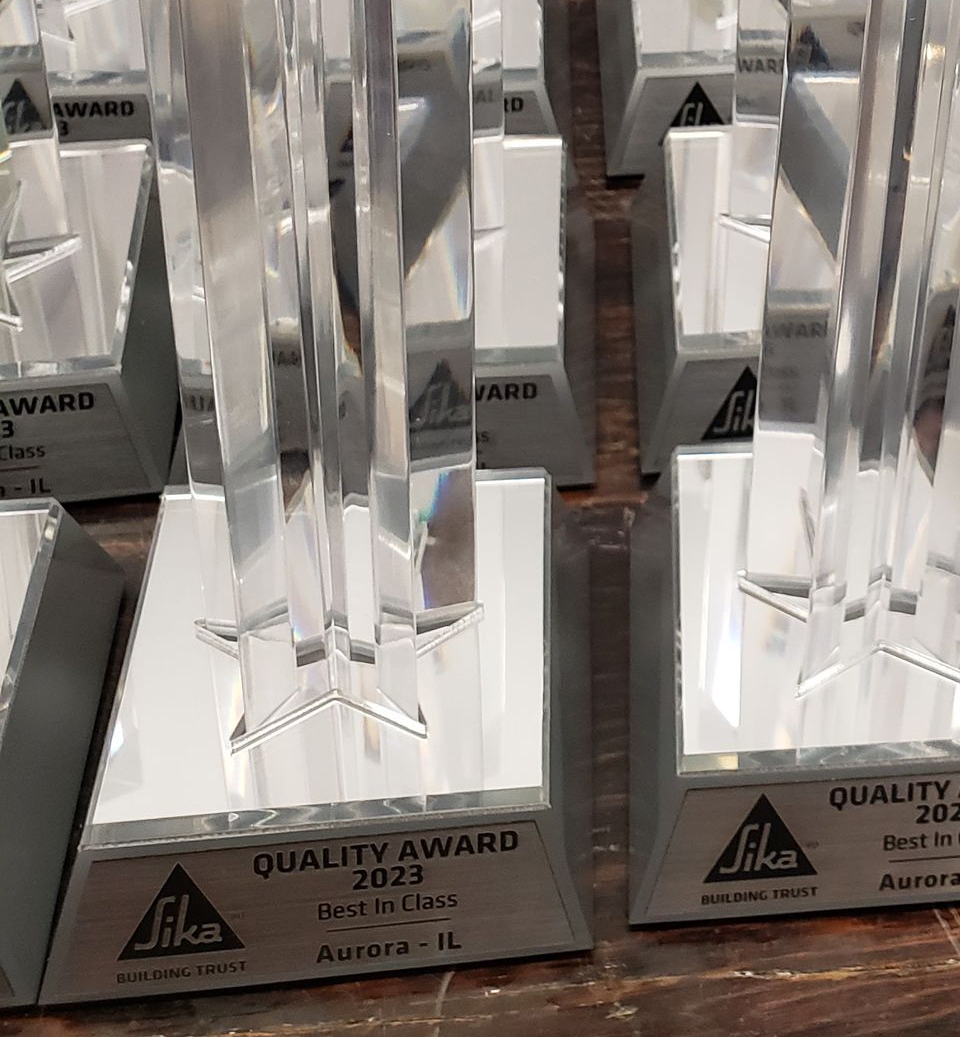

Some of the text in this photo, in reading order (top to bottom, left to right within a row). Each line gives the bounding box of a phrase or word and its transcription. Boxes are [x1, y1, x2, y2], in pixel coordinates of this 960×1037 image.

[30, 477, 51, 495] IL
[829, 779, 951, 811] QUALITY
[253, 830, 519, 879] QUALITY AWARD
[719, 822, 798, 875] Sika
[883, 832, 927, 852] Best
[934, 831, 952, 847] In
[352, 864, 424, 890] 2023
[317, 892, 459, 921] Best In Class
[701, 886, 818, 905] BUILDING TRUST
[134, 894, 223, 951] Sika
[316, 939, 409, 963] Aurora
[438, 931, 463, 951] IL
[116, 960, 247, 984] BUILDING TRUST
